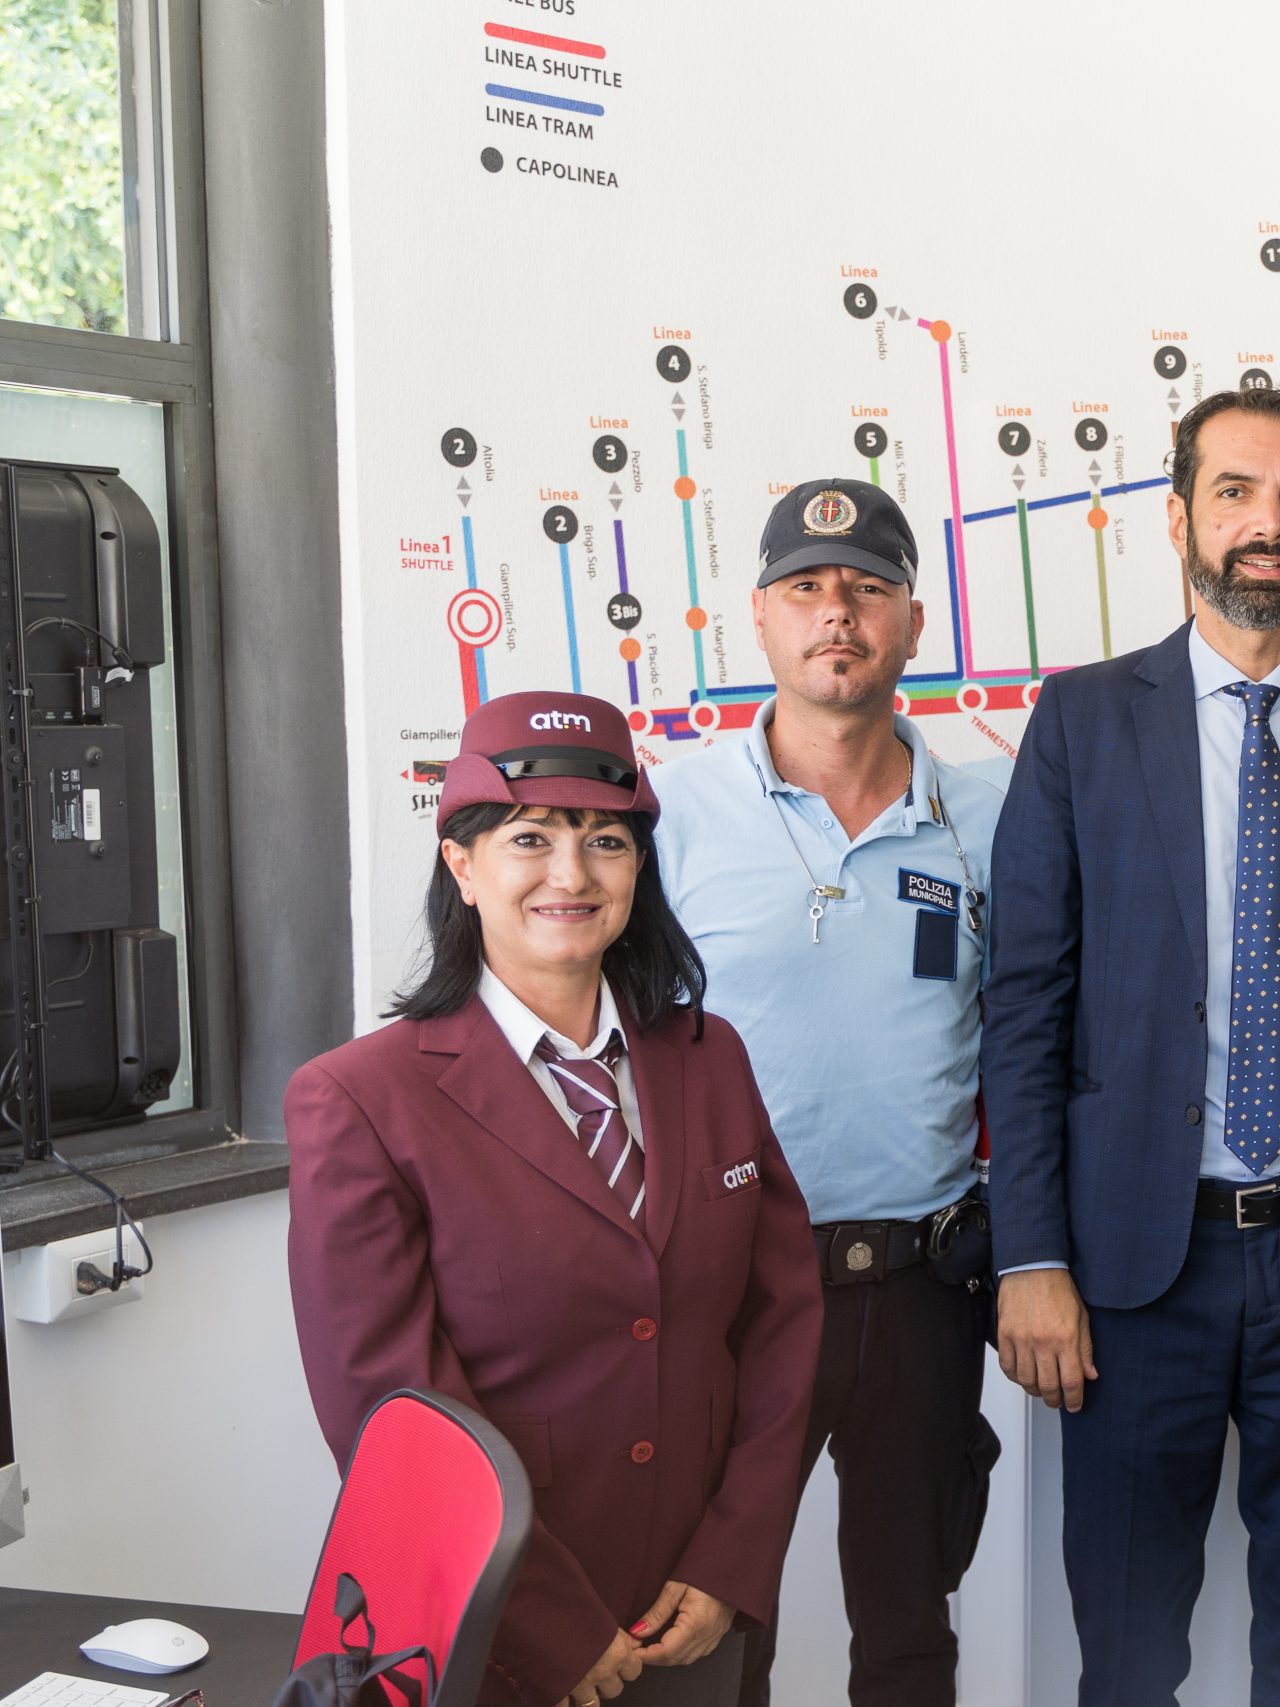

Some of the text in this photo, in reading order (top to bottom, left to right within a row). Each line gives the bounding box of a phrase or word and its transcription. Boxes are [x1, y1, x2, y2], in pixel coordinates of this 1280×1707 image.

[485, 46, 623, 88] LINEA SHUTTLE
[485, 105, 594, 141] LINEA TRAM
[516, 156, 619, 188] CAPOLINEA
[840, 265, 879, 279] Linea
[854, 292, 867, 308] 6
[653, 326, 692, 340] Linea
[874, 319, 888, 361] Tipoldo
[1151, 329, 1188, 341] Linea
[957, 331, 970, 374] Larderia
[1237, 351, 1274, 363] Linea
[667, 354, 681, 371] 4
[1164, 354, 1176, 370] 9
[698, 376, 711, 419] Stefano
[851, 404, 889, 417] Linea
[995, 405, 1032, 417] Linea
[1072, 401, 1109, 413] Linea
[589, 415, 629, 429] Linea
[702, 421, 714, 450] Briga
[865, 431, 877, 448] 5
[1008, 430, 1020, 446] 7
[1085, 426, 1098, 442] 8
[453, 438, 466, 456] 2
[604, 444, 617, 461] 3
[895, 440, 904, 459] Mili
[483, 445, 494, 482] Altolia
[1036, 439, 1048, 478] Zafferia
[631, 450, 643, 493] Pezzolo
[539, 487, 579, 501] Linea
[897, 472, 906, 503] Pietro
[554, 515, 568, 532] 2
[400, 535, 451, 555] Linea 1
[583, 525, 597, 580] Briga Sup.
[401, 557, 454, 571] SHUTTLE
[499, 562, 514, 625] Giampilieri
[529, 710, 591, 733] atm
[400, 729, 461, 743] Giampilieri
[970, 715, 1018, 760] TREMESTIE
[908, 875, 952, 899] POLIZIA
[908, 887, 954, 909] MUNICIPALE
[723, 1160, 759, 1189] atm
